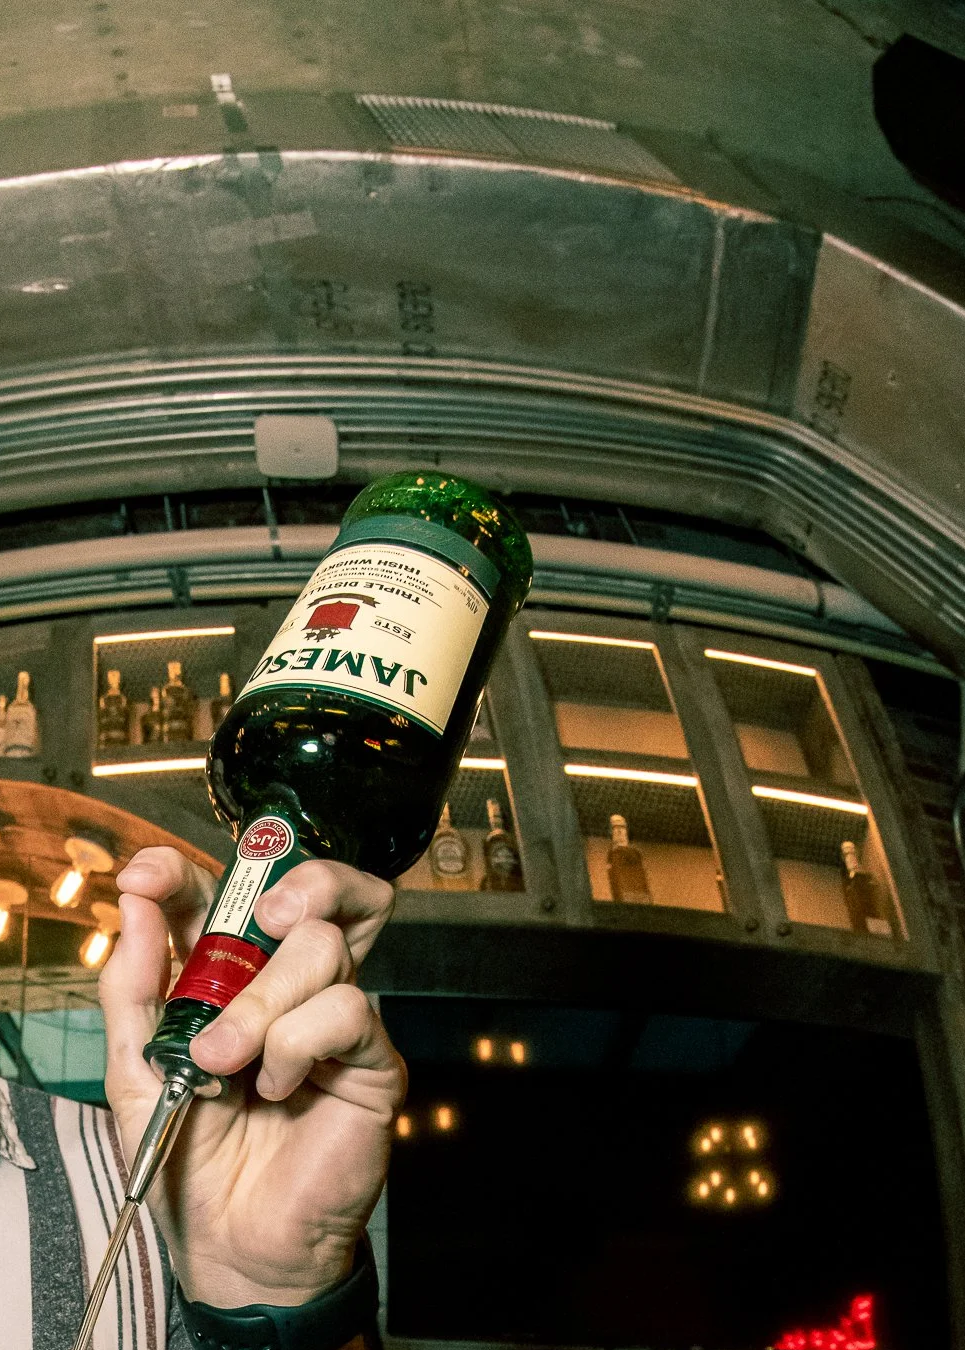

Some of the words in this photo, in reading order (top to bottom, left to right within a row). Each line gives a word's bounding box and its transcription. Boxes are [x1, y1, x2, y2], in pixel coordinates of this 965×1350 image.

[361, 567, 403, 577] JAMESON
[377, 560, 421, 575] IRISH
[368, 572, 393, 580] IRISH
[406, 575, 430, 588] JOHN
[363, 581, 421, 605] TRIPLE
[396, 577, 434, 597] SMOOTH
[272, 822, 285, 835] SON
[264, 844, 283, 857] JOHN
[223, 880, 239, 909] DISTILLED
[223, 896, 239, 924] MATURED
[238, 866, 253, 891] BOTTLED
[240, 879, 255, 905] IRELAND
